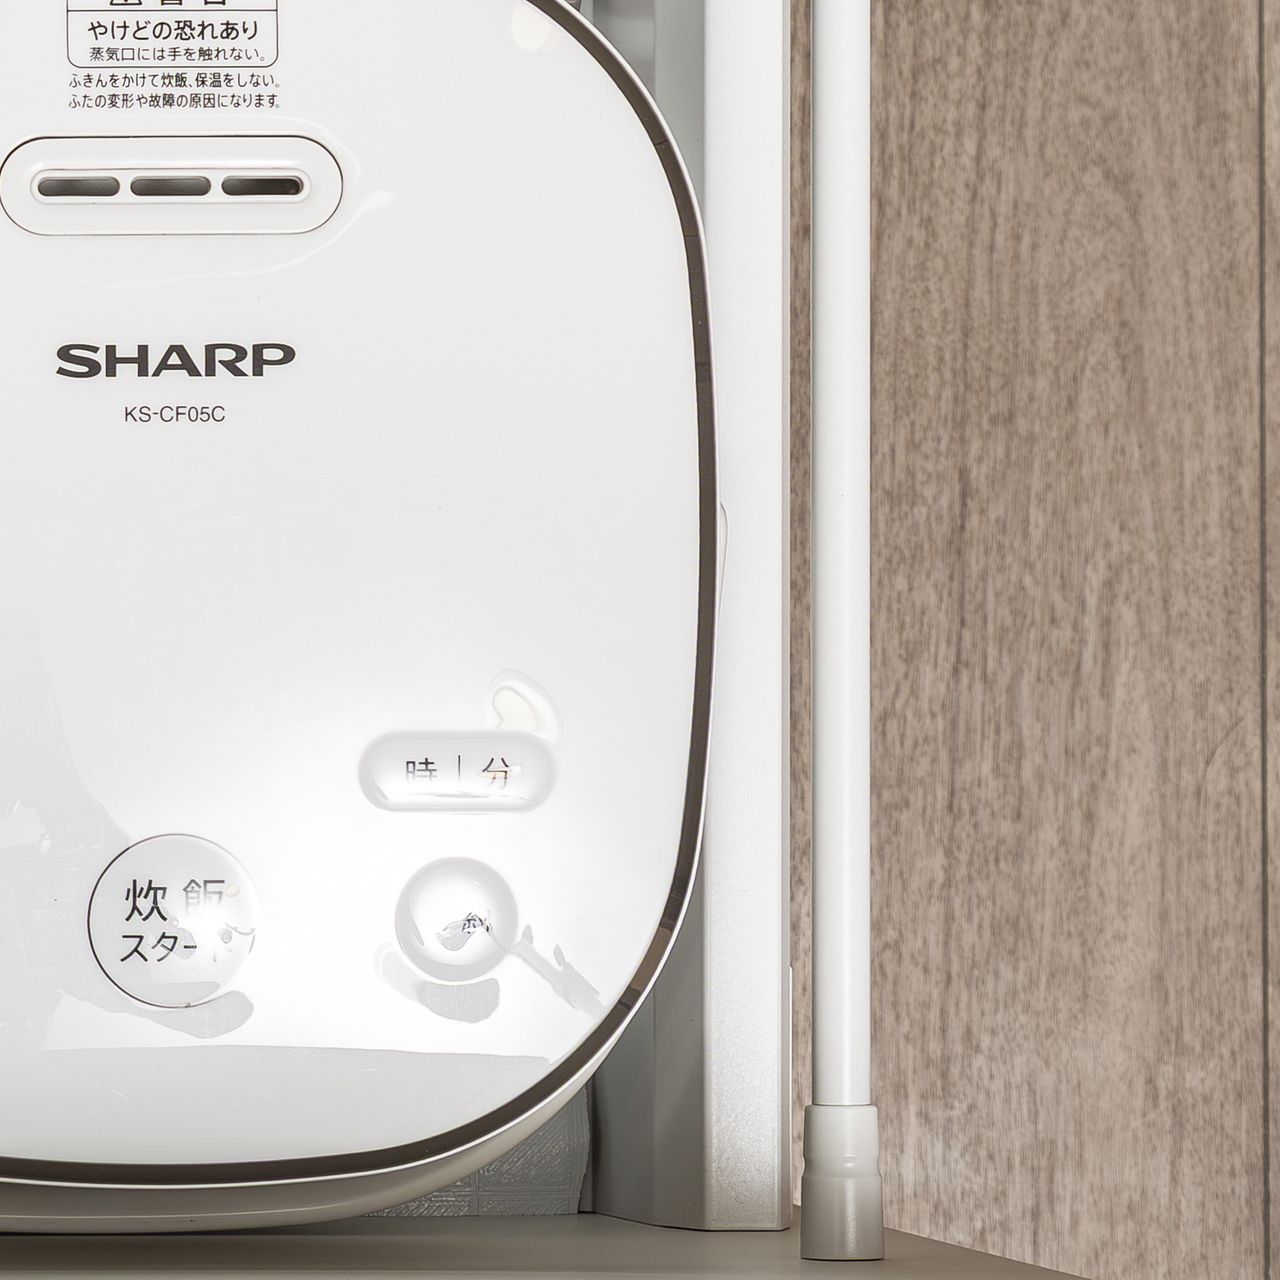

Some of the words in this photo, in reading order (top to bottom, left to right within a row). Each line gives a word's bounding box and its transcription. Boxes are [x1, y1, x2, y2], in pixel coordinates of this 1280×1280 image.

[88, 20, 259, 41] やけどの恐れあり
[89, 47, 266, 61] 蒸気口には手を触れない。
[69, 73, 280, 88] ふきんをかけて炊飯、保温をしない。
[69, 93, 280, 109] ふたの変形や故障の原因になります。
[56, 343, 296, 378] SHARP
[124, 406, 225, 423] KS-CF05C
[482, 758, 509, 789] 分
